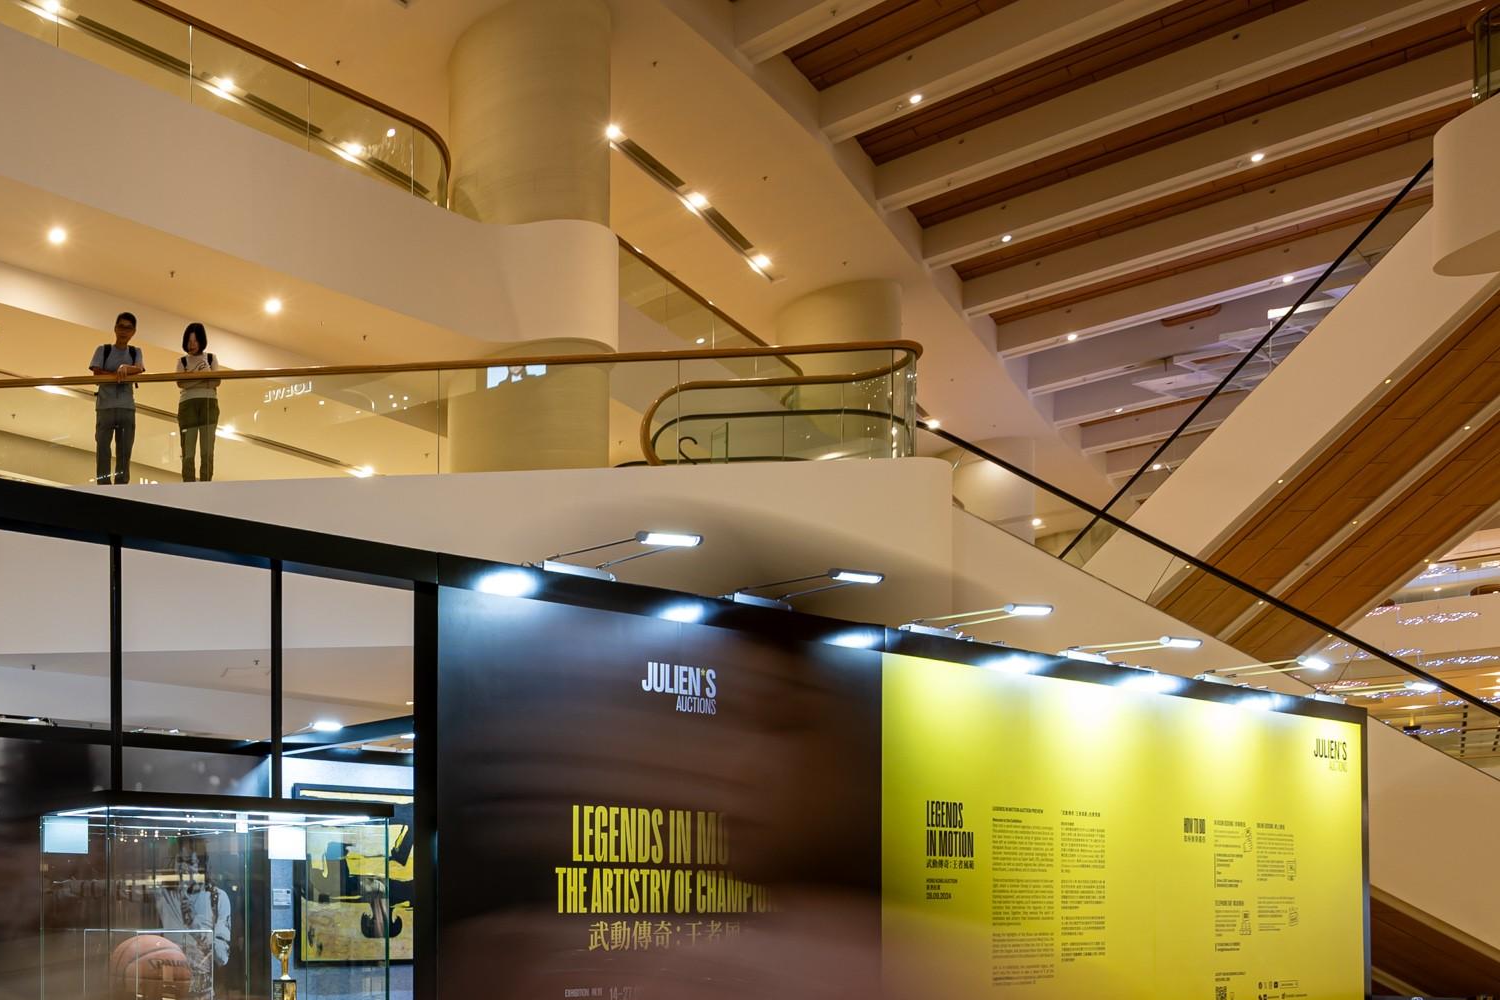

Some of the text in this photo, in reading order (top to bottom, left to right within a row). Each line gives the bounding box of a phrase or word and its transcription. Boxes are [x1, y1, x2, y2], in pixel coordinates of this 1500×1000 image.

[675, 695, 717, 715] AUCTIONS
[926, 800, 964, 828] LEGENDS
[572, 805, 664, 864] LEGENDS
[669, 810, 692, 864] IN
[926, 830, 936, 856] IN
[938, 831, 974, 857] MOTION
[555, 867, 588, 913] THE
[591, 868, 671, 913] ARTISTRY
[674, 869, 693, 913] OF
